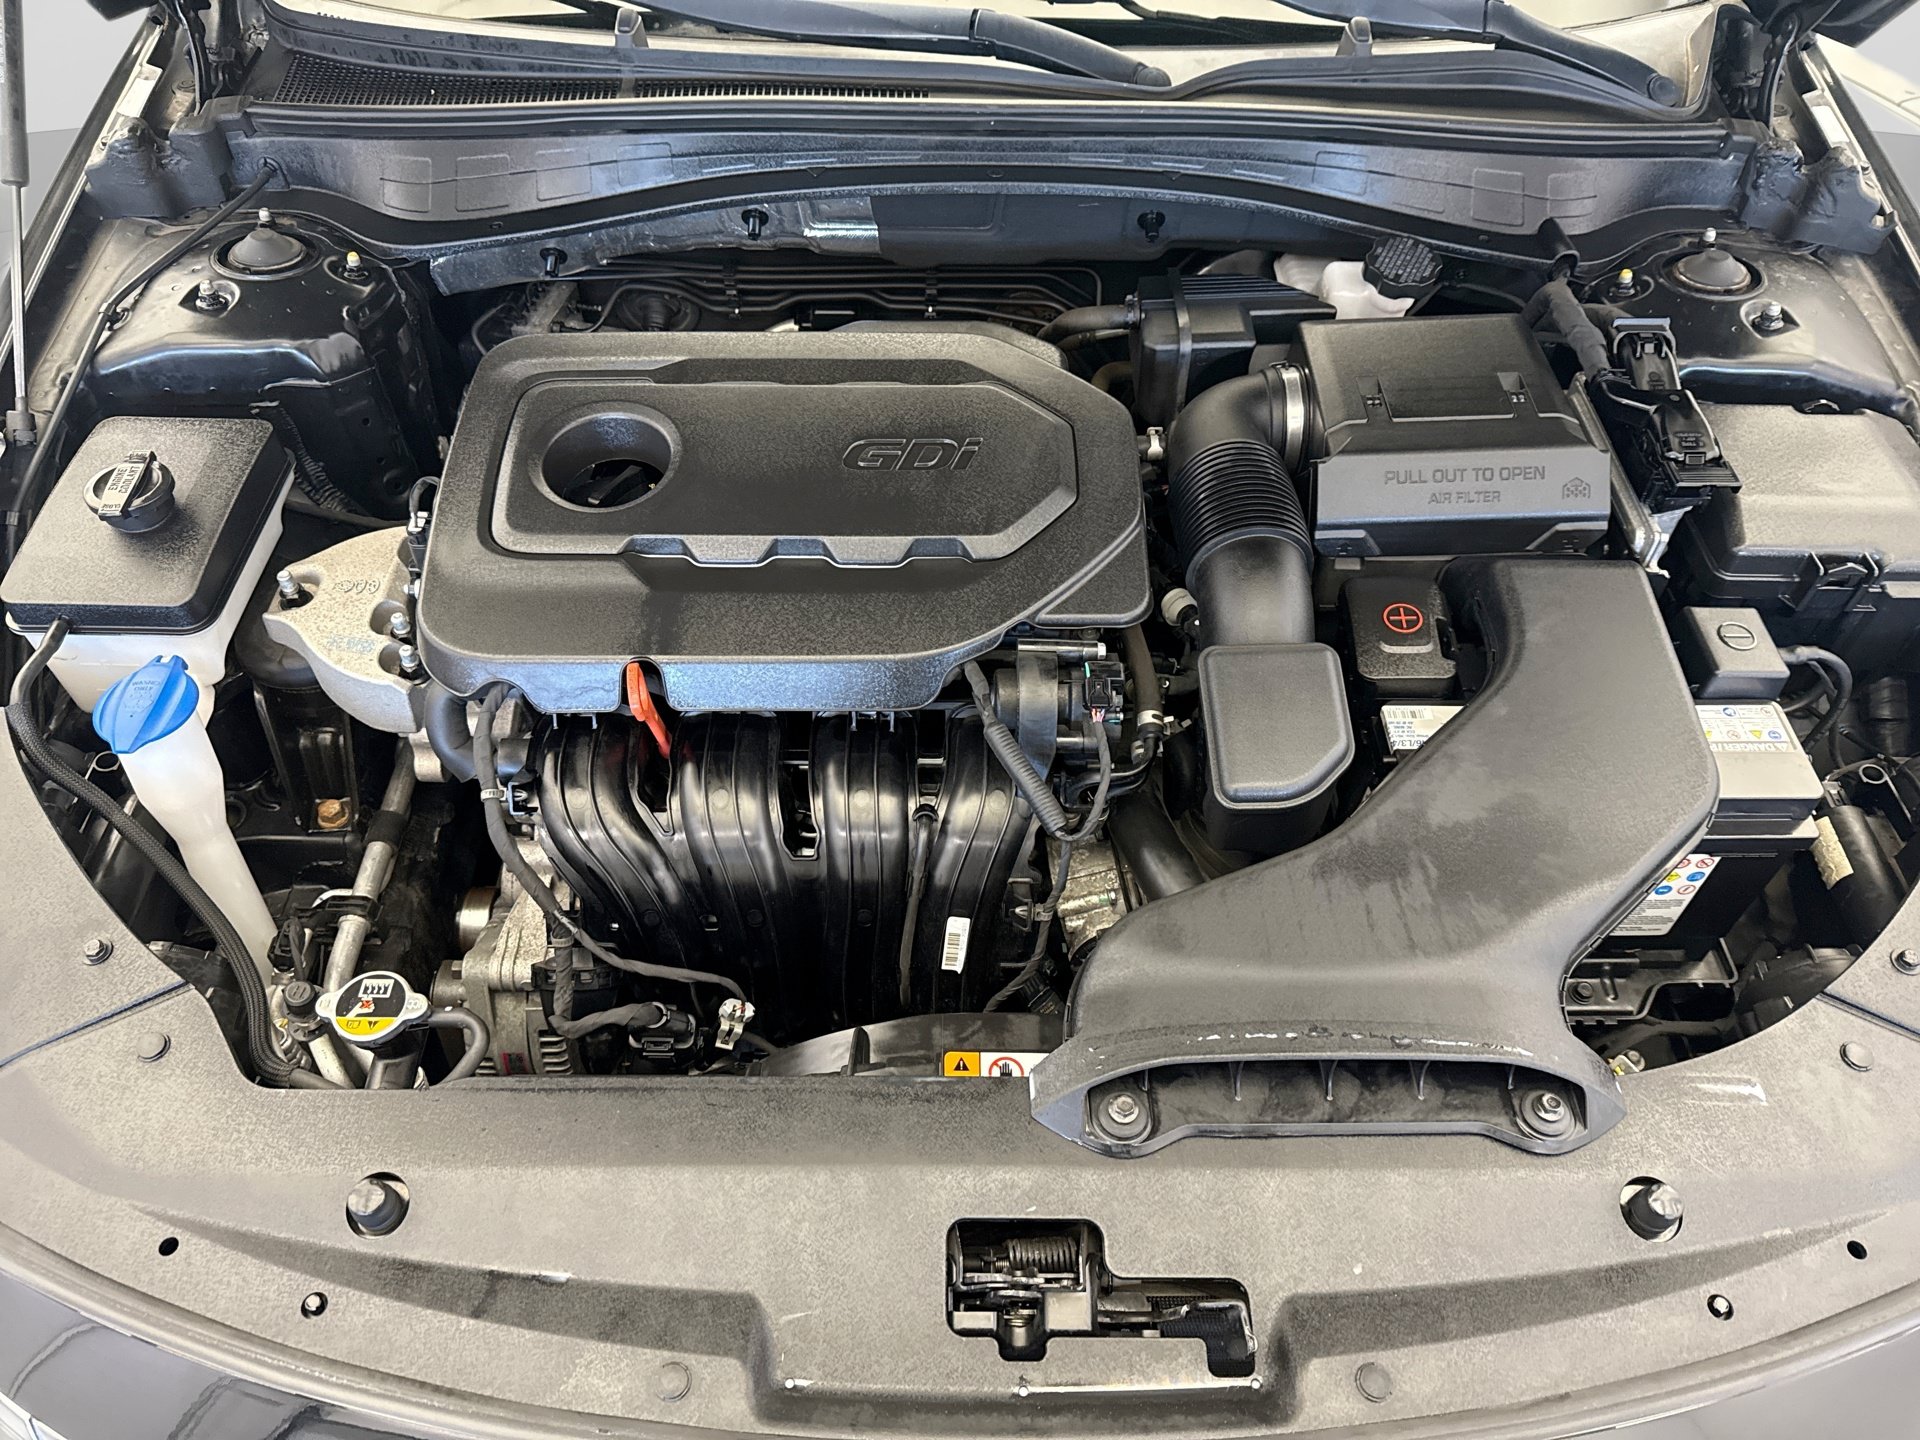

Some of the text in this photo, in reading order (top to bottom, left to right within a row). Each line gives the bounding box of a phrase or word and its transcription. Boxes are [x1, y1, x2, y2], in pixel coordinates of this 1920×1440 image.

[841, 437, 984, 471] GDi
[1384, 466, 1546, 485] PULL OUT TO OPEN
[1428, 490, 1501, 504] AIR FILTER
